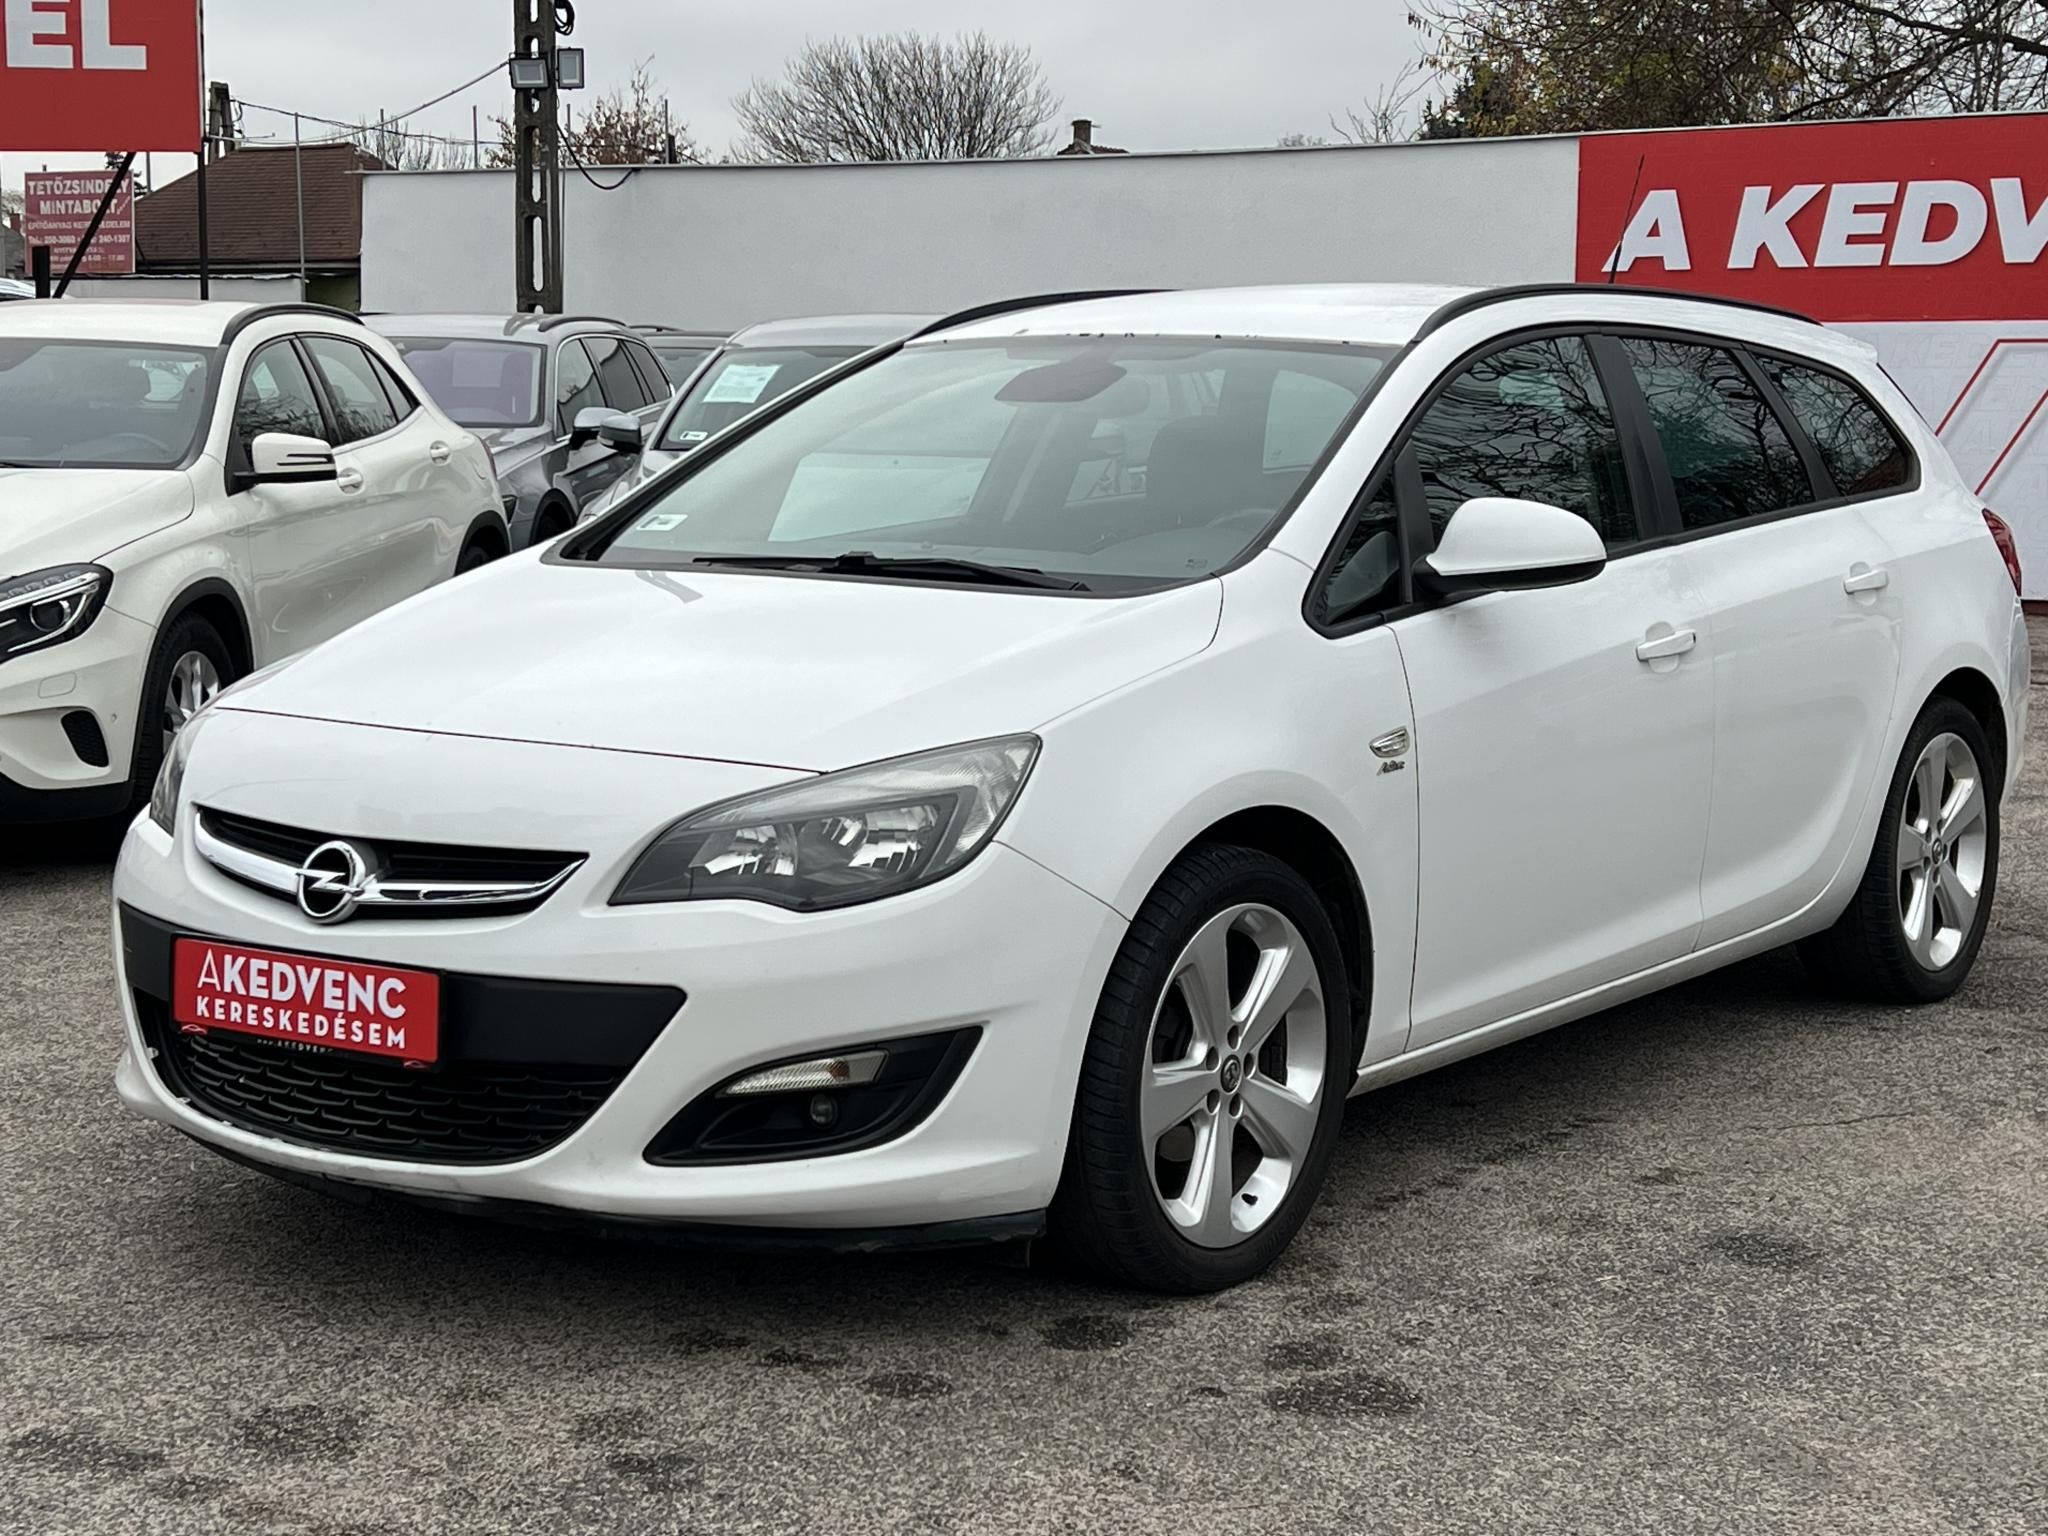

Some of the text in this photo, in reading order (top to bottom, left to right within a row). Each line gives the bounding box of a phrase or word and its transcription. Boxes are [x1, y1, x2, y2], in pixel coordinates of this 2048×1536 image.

[40, 198, 118, 215] MINTABOT
[1601, 188, 1692, 273] A
[196, 996, 406, 1049] KERESKEDÉSEM
